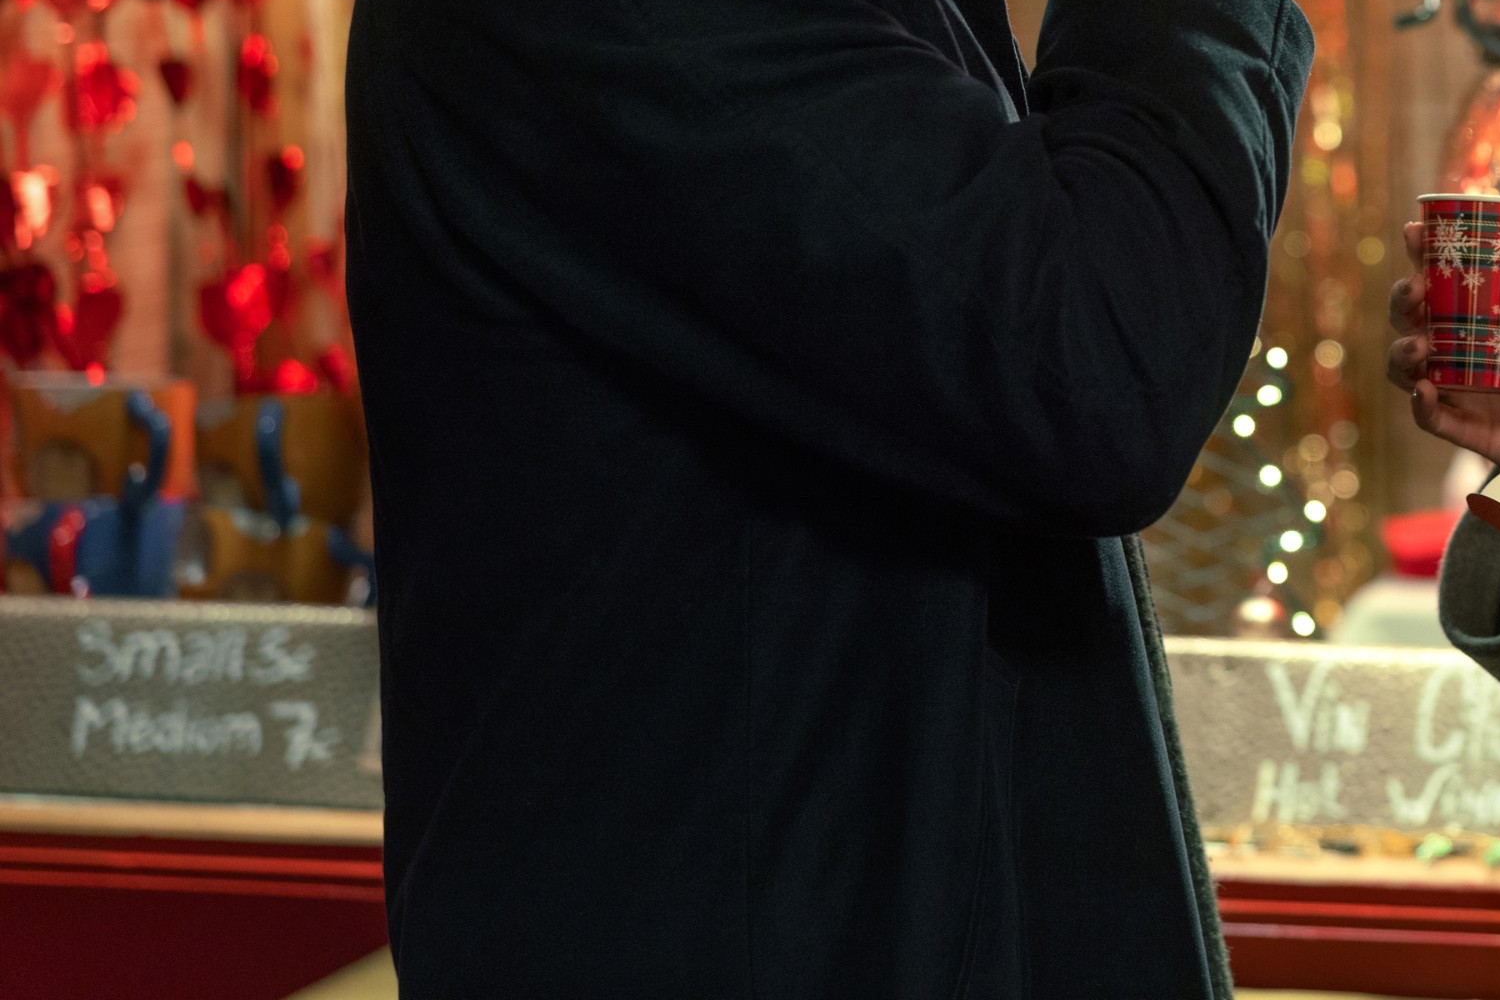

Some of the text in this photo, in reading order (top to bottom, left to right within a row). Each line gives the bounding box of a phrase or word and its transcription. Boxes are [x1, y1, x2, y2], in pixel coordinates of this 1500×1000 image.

[75, 617, 248, 687] Small
[71, 696, 264, 762] Medium
[1266, 660, 1370, 755] Vin
[1251, 757, 1348, 825] Hot
